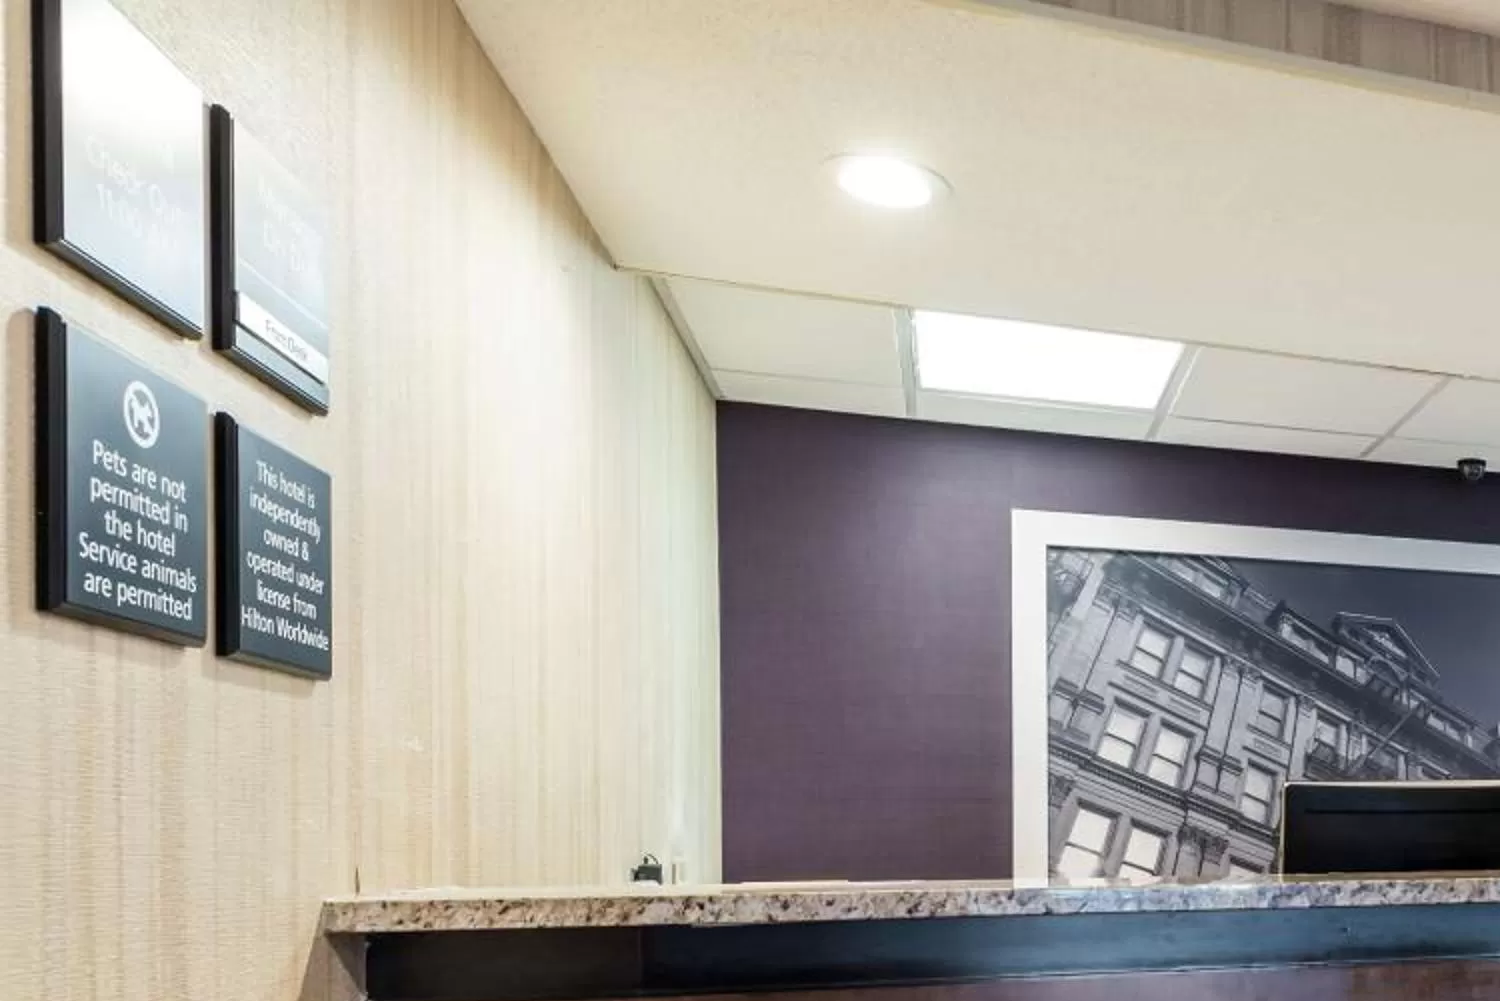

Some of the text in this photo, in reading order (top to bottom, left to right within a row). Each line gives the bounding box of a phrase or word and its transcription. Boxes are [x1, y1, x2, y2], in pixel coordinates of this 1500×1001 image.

[93, 439, 187, 504] Pets are not
[256, 460, 315, 509] This hotel is
[90, 476, 189, 534] permitted in
[249, 486, 321, 544] independently
[104, 509, 176, 557] the hotel
[263, 529, 309, 561] owned &
[79, 531, 197, 593] Service animals
[247, 551, 324, 595] operated under
[84, 572, 193, 621] are permitted
[257, 579, 317, 620] license from
[241, 604, 329, 651] Hilton Worldwide
